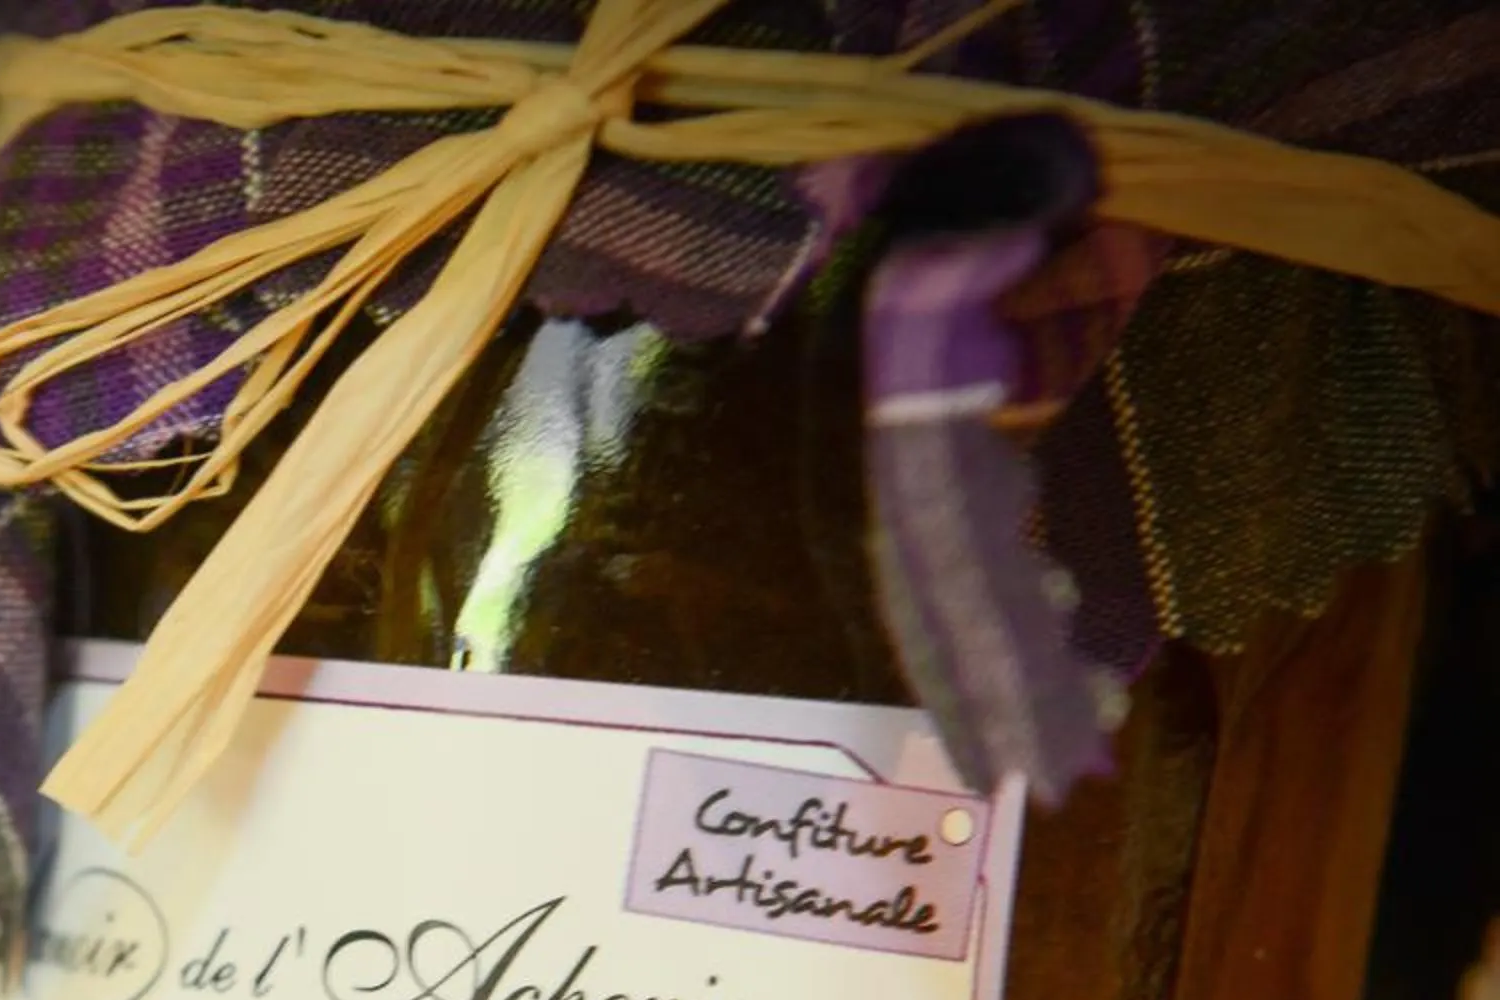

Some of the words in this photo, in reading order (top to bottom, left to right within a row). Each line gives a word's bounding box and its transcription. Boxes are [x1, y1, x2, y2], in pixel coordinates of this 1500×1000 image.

[694, 788, 936, 866] Confiture
[655, 847, 941, 936] Artisanale
[179, 927, 240, 994] de
